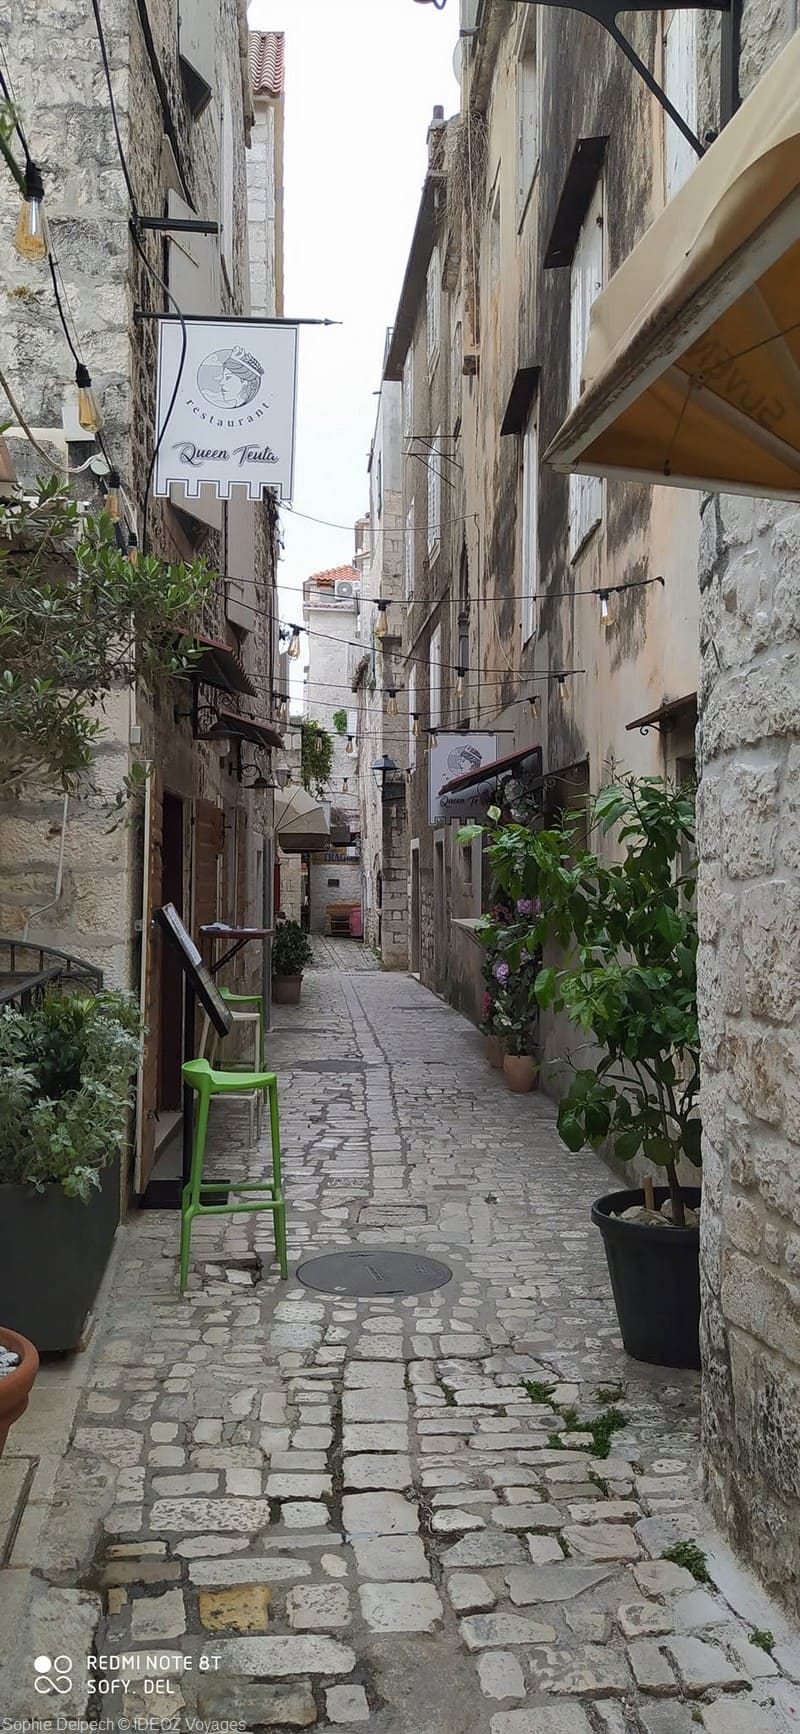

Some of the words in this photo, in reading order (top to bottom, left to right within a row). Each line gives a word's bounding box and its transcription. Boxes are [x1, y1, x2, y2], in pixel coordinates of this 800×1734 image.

[185, 398, 271, 428] restaurant
[172, 441, 230, 468] Queen
[233, 443, 280, 468] Teuta
